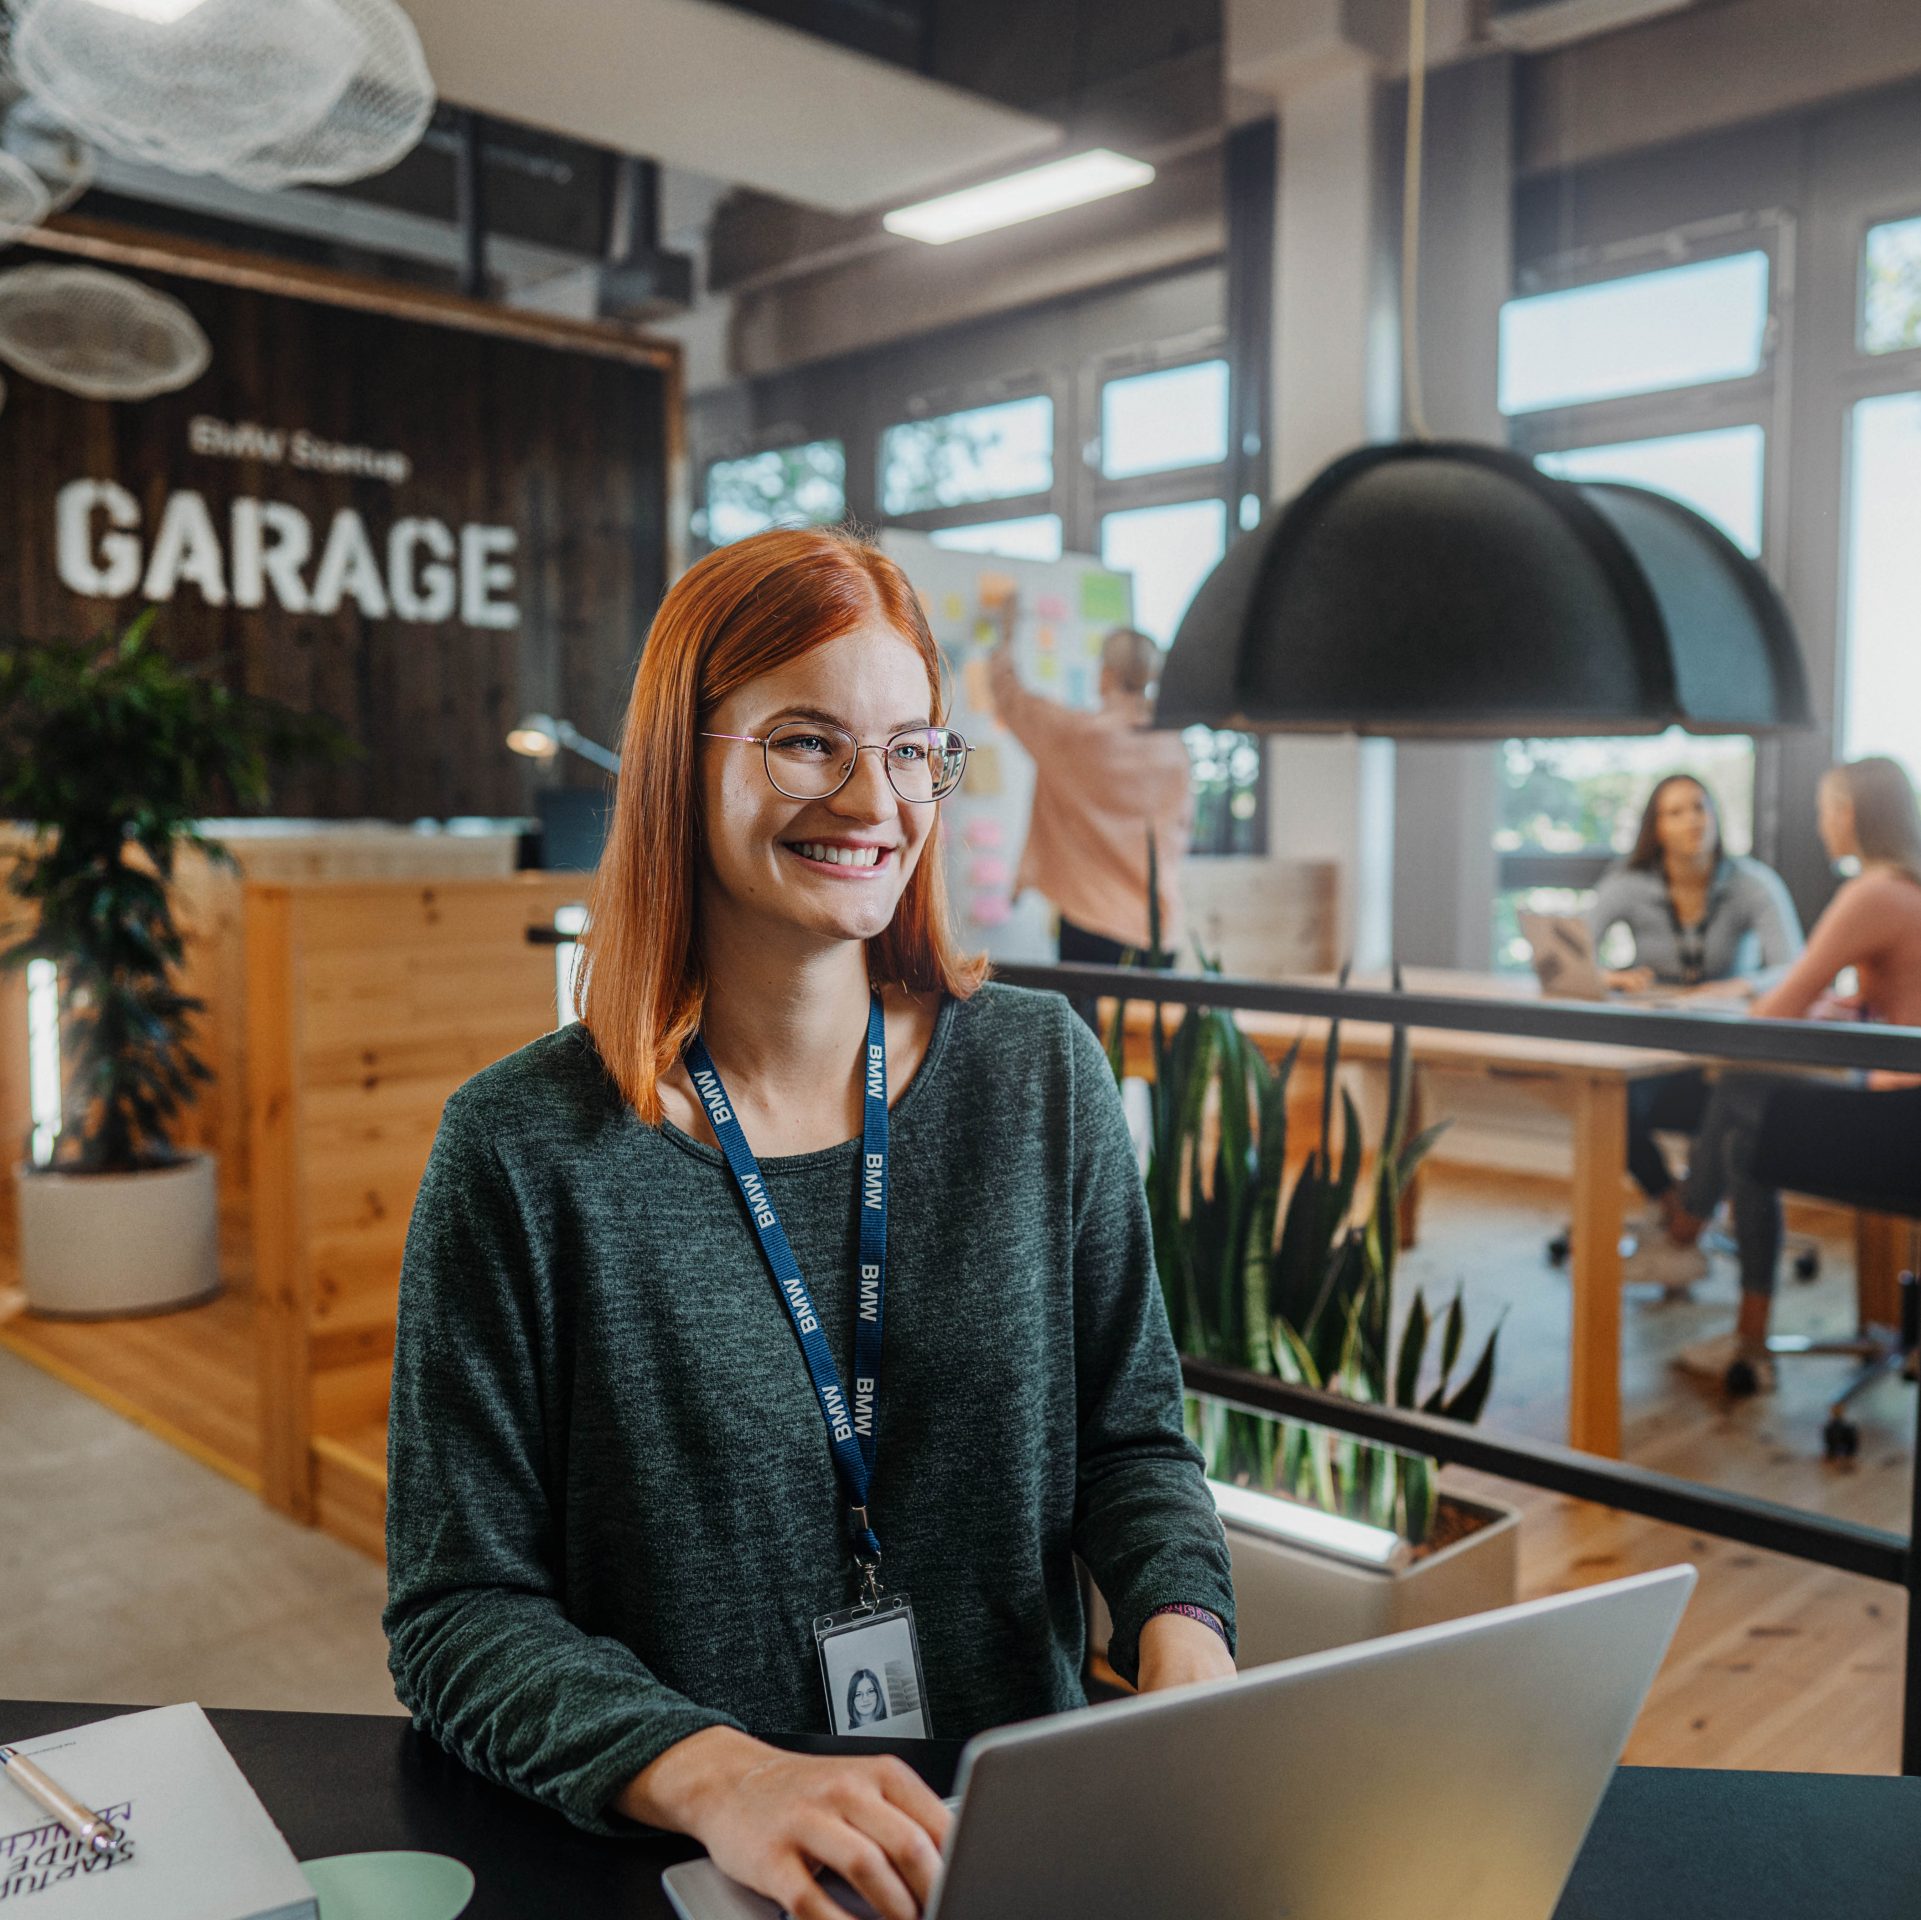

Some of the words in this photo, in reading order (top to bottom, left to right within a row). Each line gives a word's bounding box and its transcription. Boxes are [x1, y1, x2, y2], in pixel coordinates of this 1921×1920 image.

[190, 416, 284, 463] BMW
[55, 477, 521, 629] GARAGE
[694, 1070, 732, 1125] BMW
[867, 1044, 884, 1099] BMW
[740, 1173, 776, 1229] BMW
[864, 1154, 883, 1210] BMW
[783, 1278, 818, 1335] BMW
[859, 1264, 880, 1322] BMW
[821, 1385, 852, 1443] BMW
[854, 1378, 875, 1437] BMW
